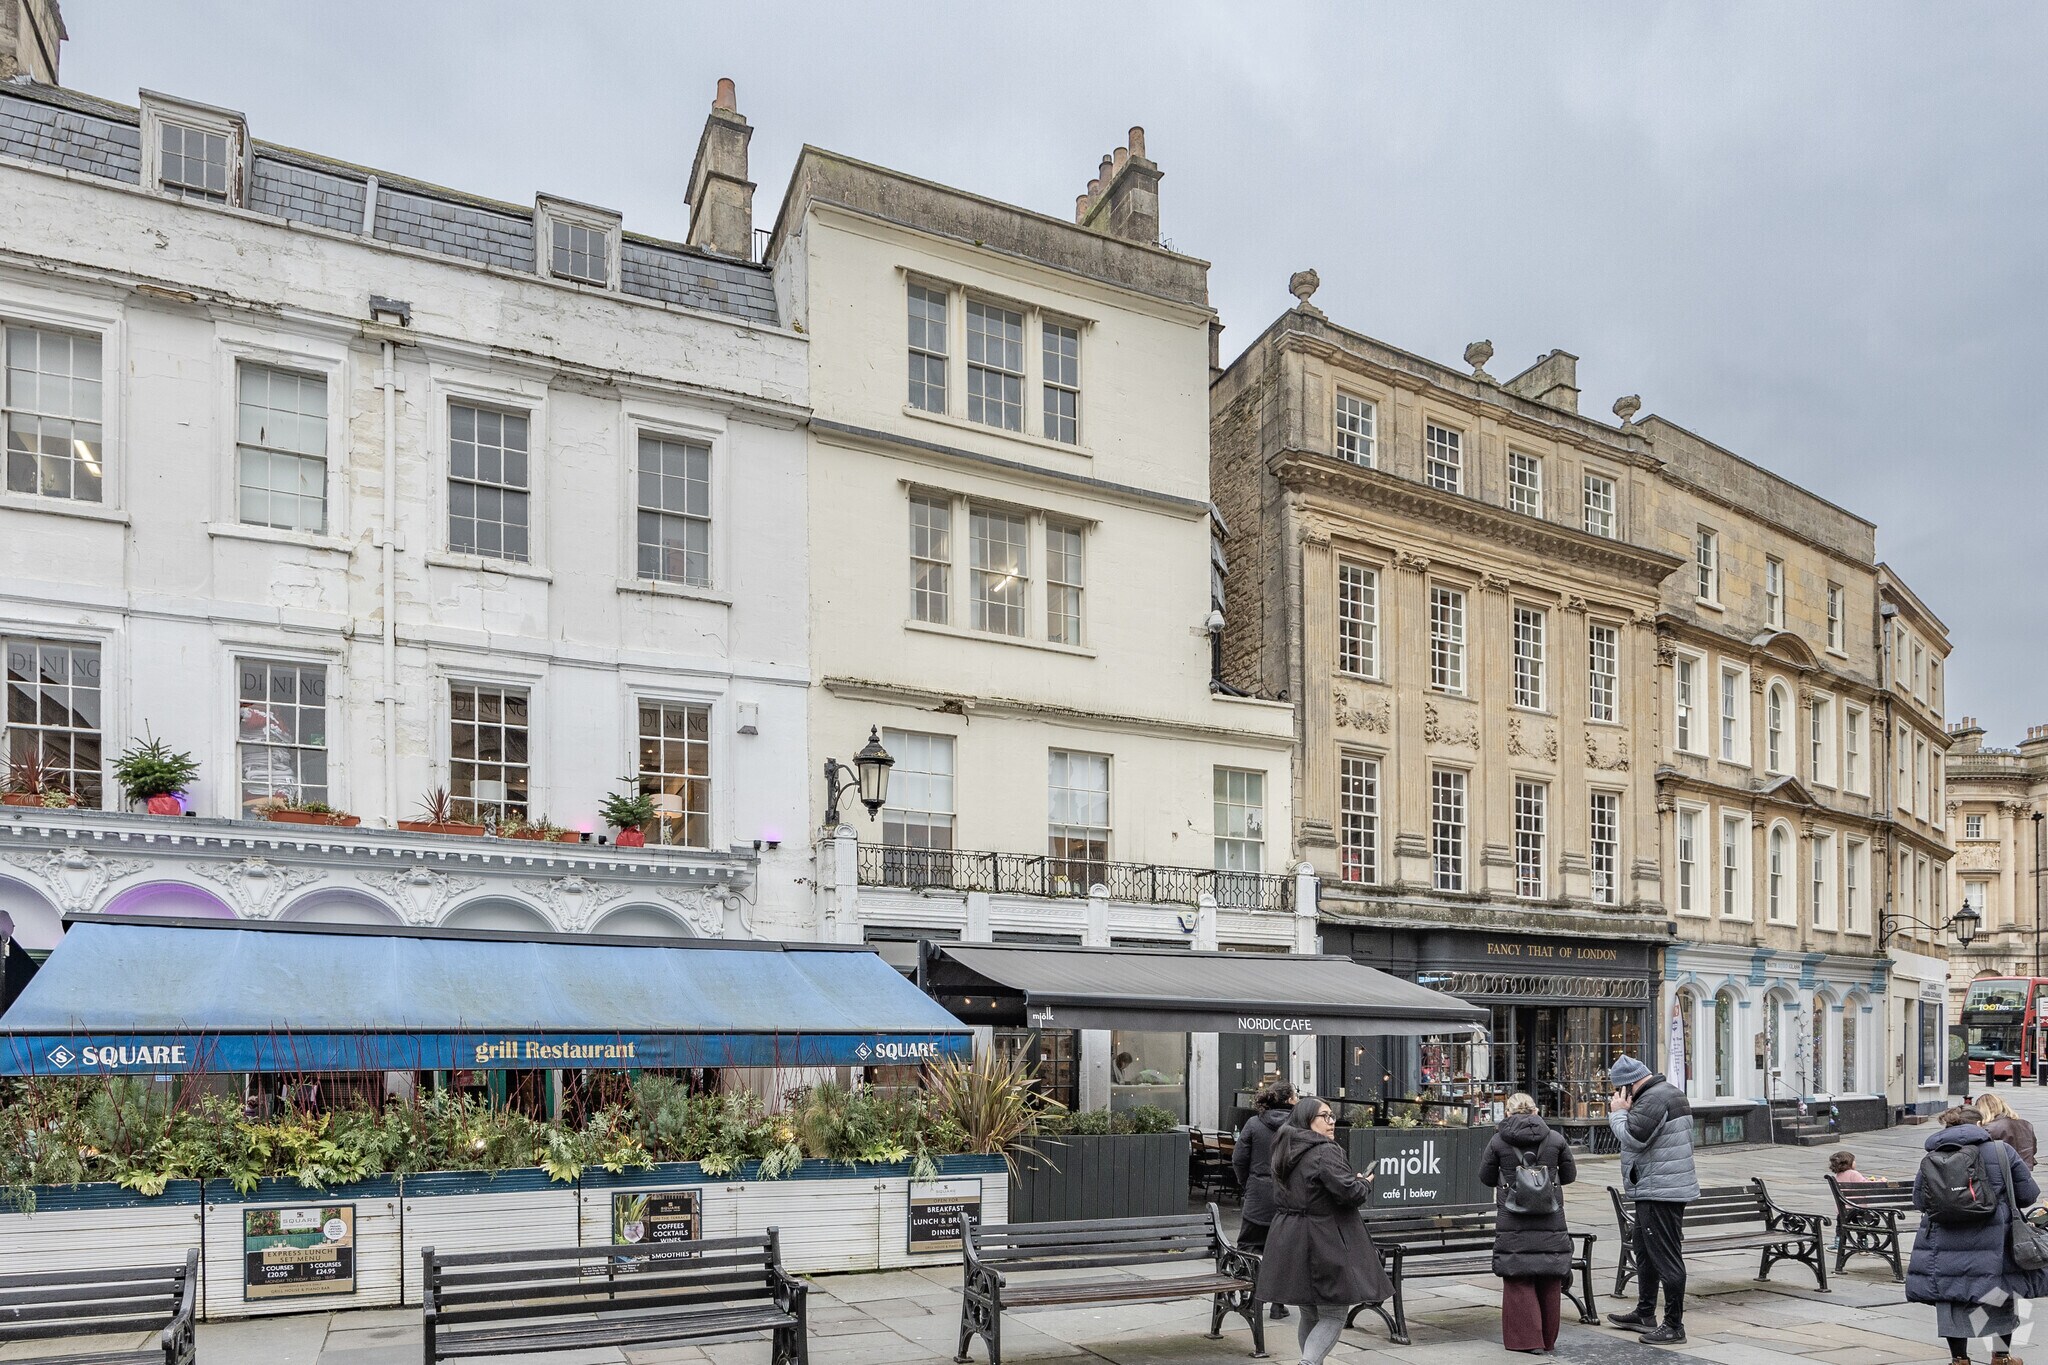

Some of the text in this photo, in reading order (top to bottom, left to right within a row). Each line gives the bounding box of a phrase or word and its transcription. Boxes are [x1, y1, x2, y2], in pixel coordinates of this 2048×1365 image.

[1487, 943, 1617, 960] FANCY THAT OF LONDON
[1238, 1017, 1312, 1031] NORDIC CAFE
[82, 1045, 187, 1068] SQUARE
[475, 1041, 635, 1063] grill Restaurant
[875, 1042, 939, 1060] SQUARE
[1380, 1140, 1441, 1187] mjölk
[1382, 1188, 1400, 1199] café
[1409, 1187, 1437, 1199] bakery
[927, 1205, 965, 1213] BREAKFAST
[656, 1222, 684, 1230] COFFEES
[913, 1218, 939, 1226] LUNCH
[948, 1216, 978, 1224] BRUCH
[652, 1229, 689, 1237] COCKTAILS
[931, 1228, 960, 1236] DINNER
[267, 1248, 333, 1258] EXPRESS LUNCH
[651, 1251, 690, 1259] SMOOTHIES
